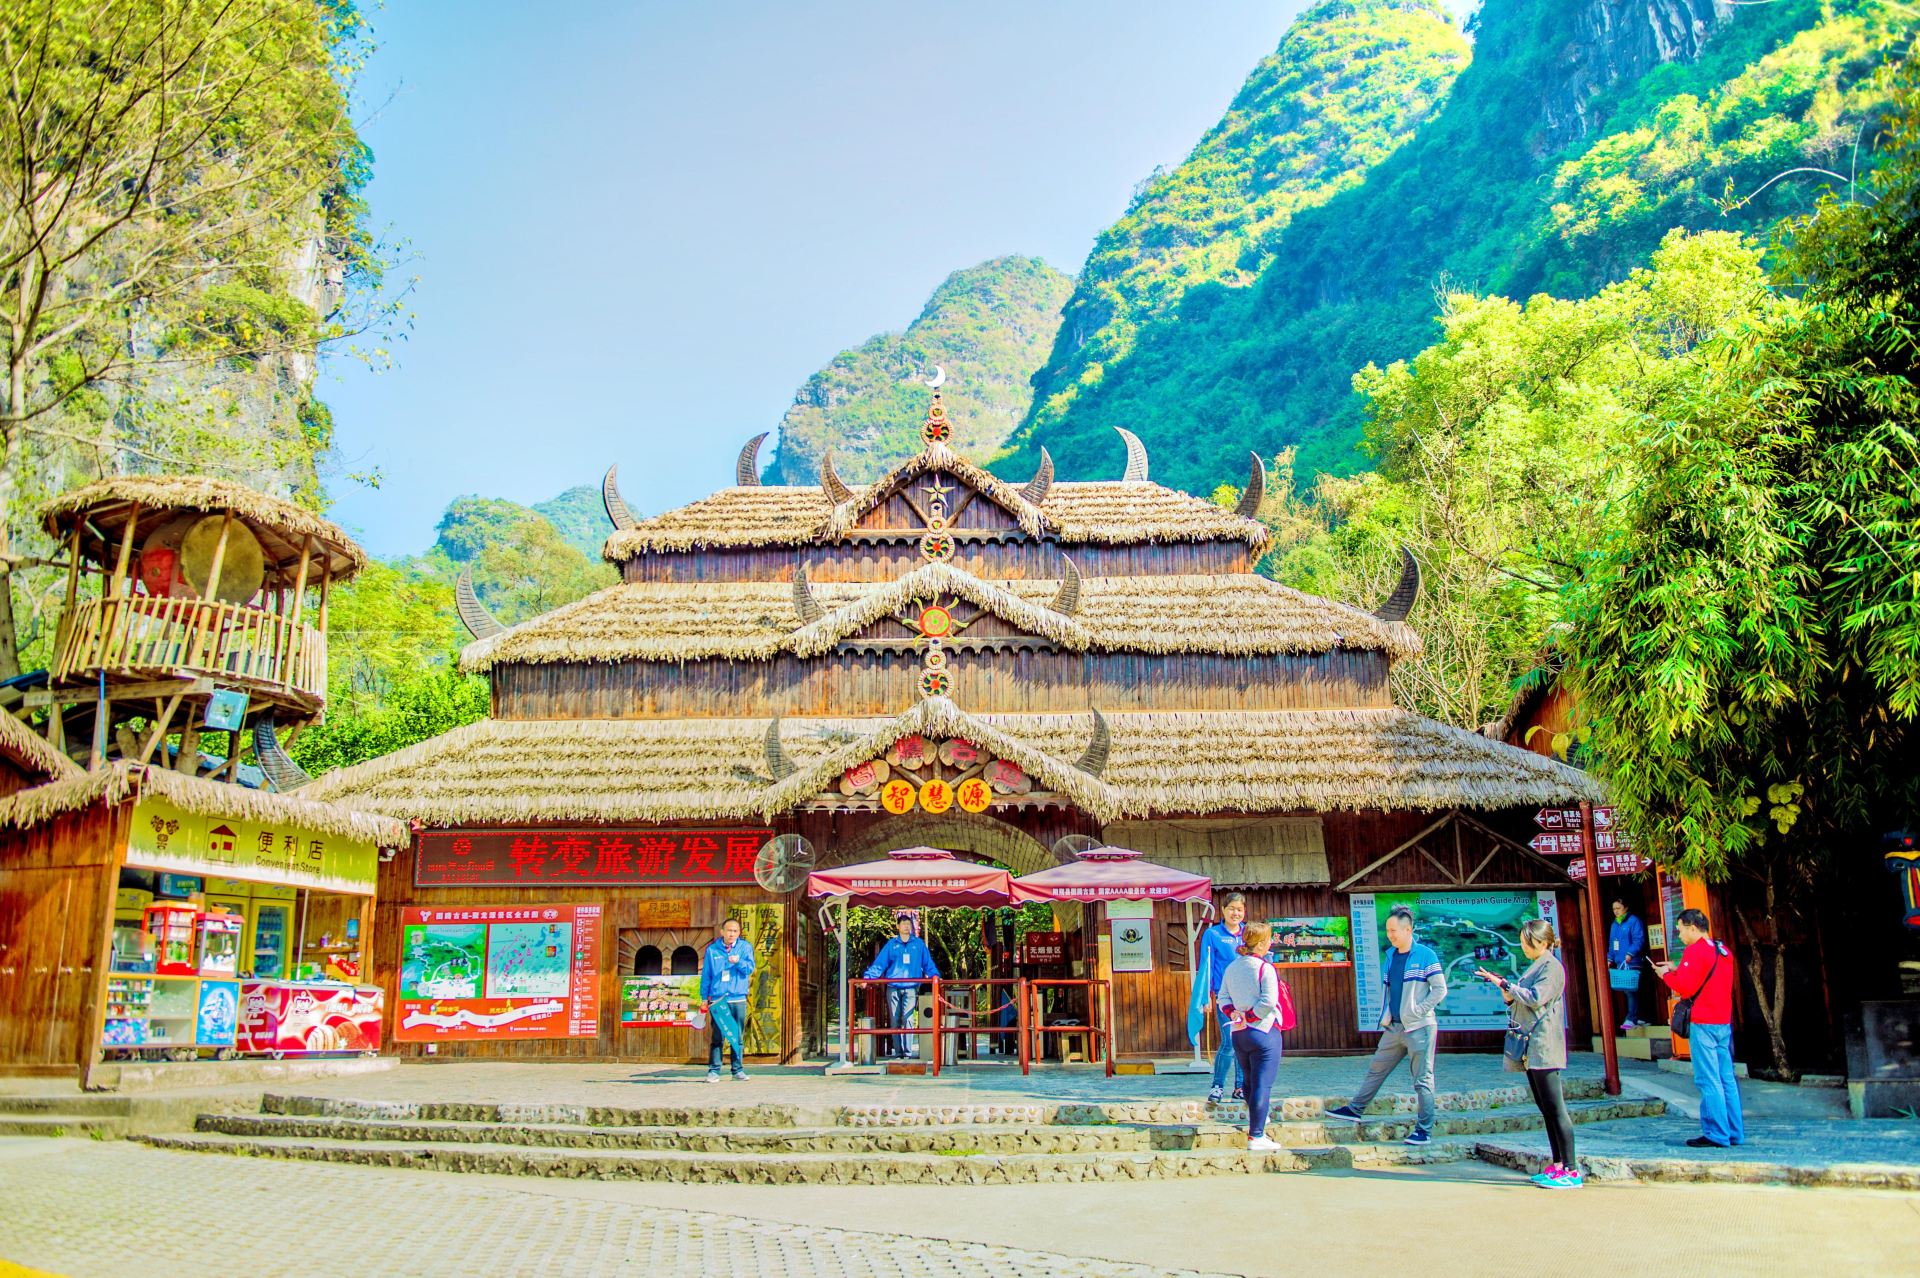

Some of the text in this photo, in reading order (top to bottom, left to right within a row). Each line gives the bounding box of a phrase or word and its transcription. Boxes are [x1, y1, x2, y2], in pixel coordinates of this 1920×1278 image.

[886, 782, 987, 811] 智慧源
[257, 830, 325, 861] 便利店
[510, 836, 758, 878] 转变旅游发展
[255, 855, 322, 874] Convenient Store
[1415, 896, 1530, 906] Ancient Totem path Guide Map
[1029, 946, 1062, 955] 无烟景区
